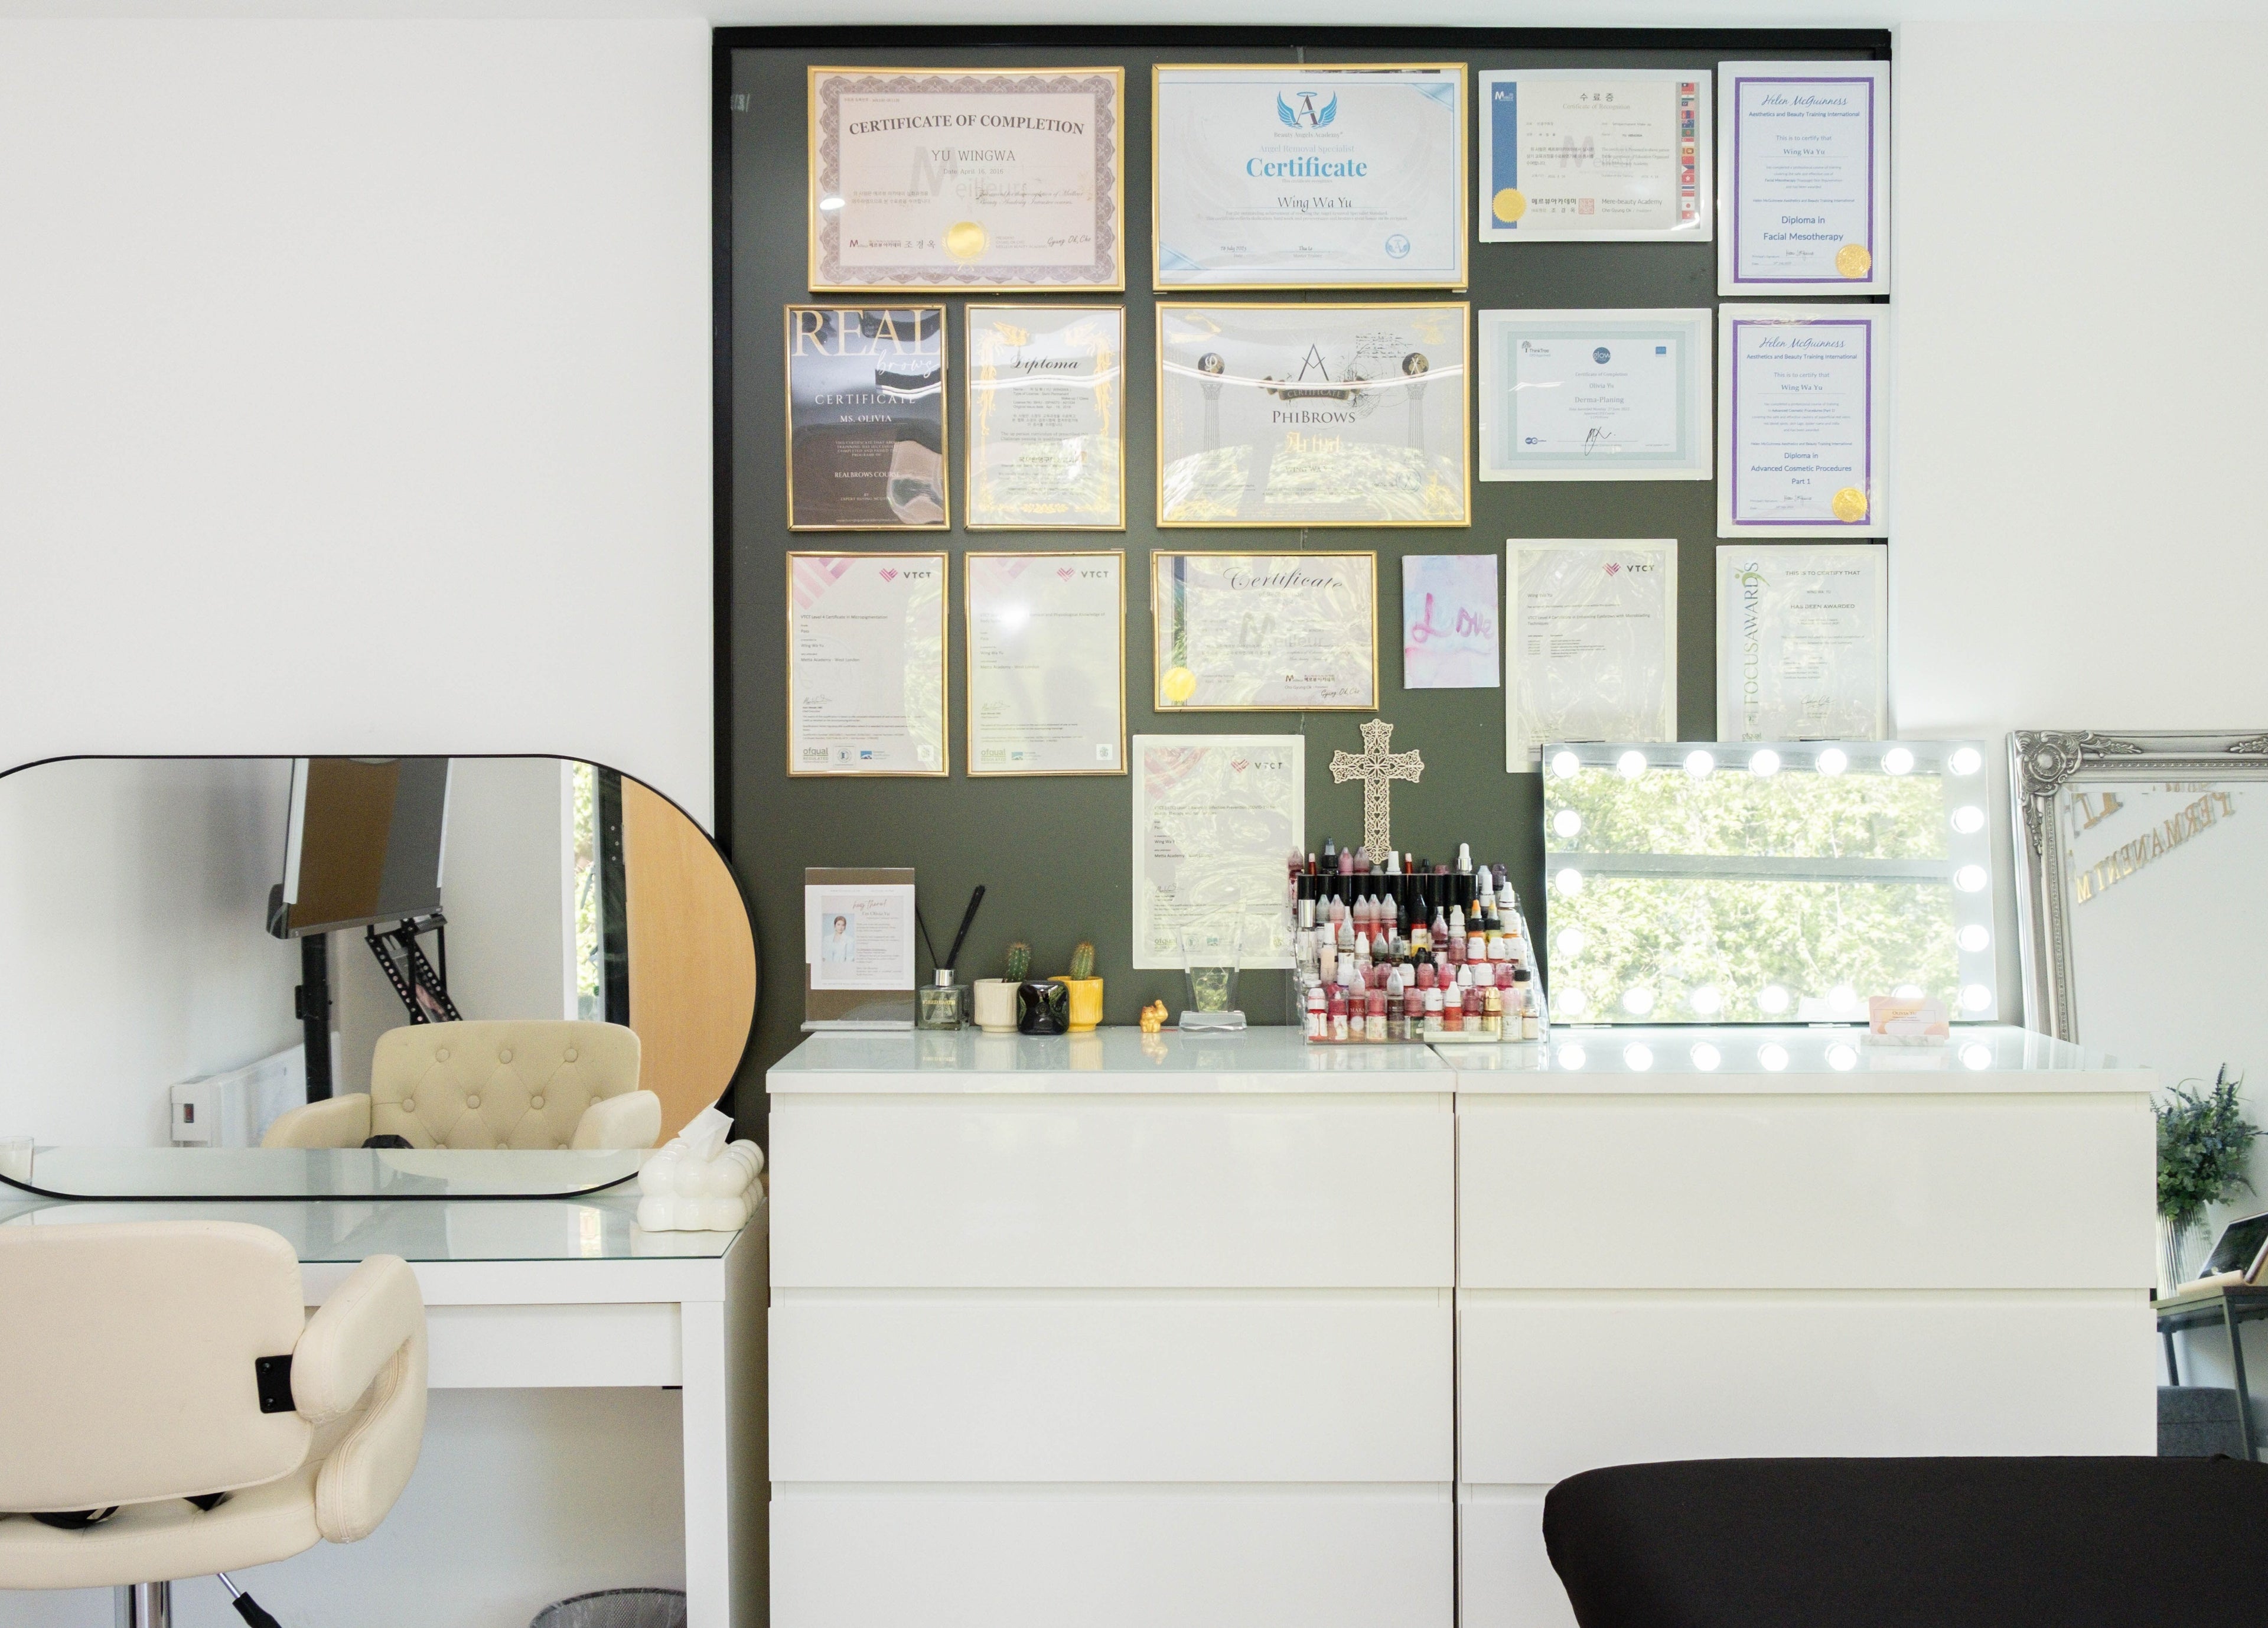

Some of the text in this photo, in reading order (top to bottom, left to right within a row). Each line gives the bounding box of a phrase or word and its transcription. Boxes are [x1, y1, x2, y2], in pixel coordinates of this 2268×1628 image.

[1761, 94, 1847, 107] Helen McGuinness
[1563, 103, 1591, 111] Certificate
[1599, 103, 1630, 111] Recognition
[849, 115, 1084, 135] CERTIFICATE OF COMPLETION
[932, 150, 1016, 161] YU WINGWA
[1259, 145, 1355, 154] Angel Removal Specialist
[1246, 156, 1367, 177] Certificate
[1278, 196, 1352, 212] Wing Wa Yu
[1781, 216, 1825, 224] Diploma in
[1764, 232, 1843, 241] Facial Mesotherapy
[791, 310, 940, 356] REAL
[1759, 336, 1845, 350] Helen McGuinness
[876, 349, 940, 378] brows
[1009, 346, 1081, 374] Diploma
[815, 394, 915, 405] CERTIFICATE
[1575, 396, 1624, 404] Derma-Planing
[1223, 566, 1342, 590] Certificate
[803, 747, 828, 756] ofqual
[981, 748, 1006, 757] ofqual
